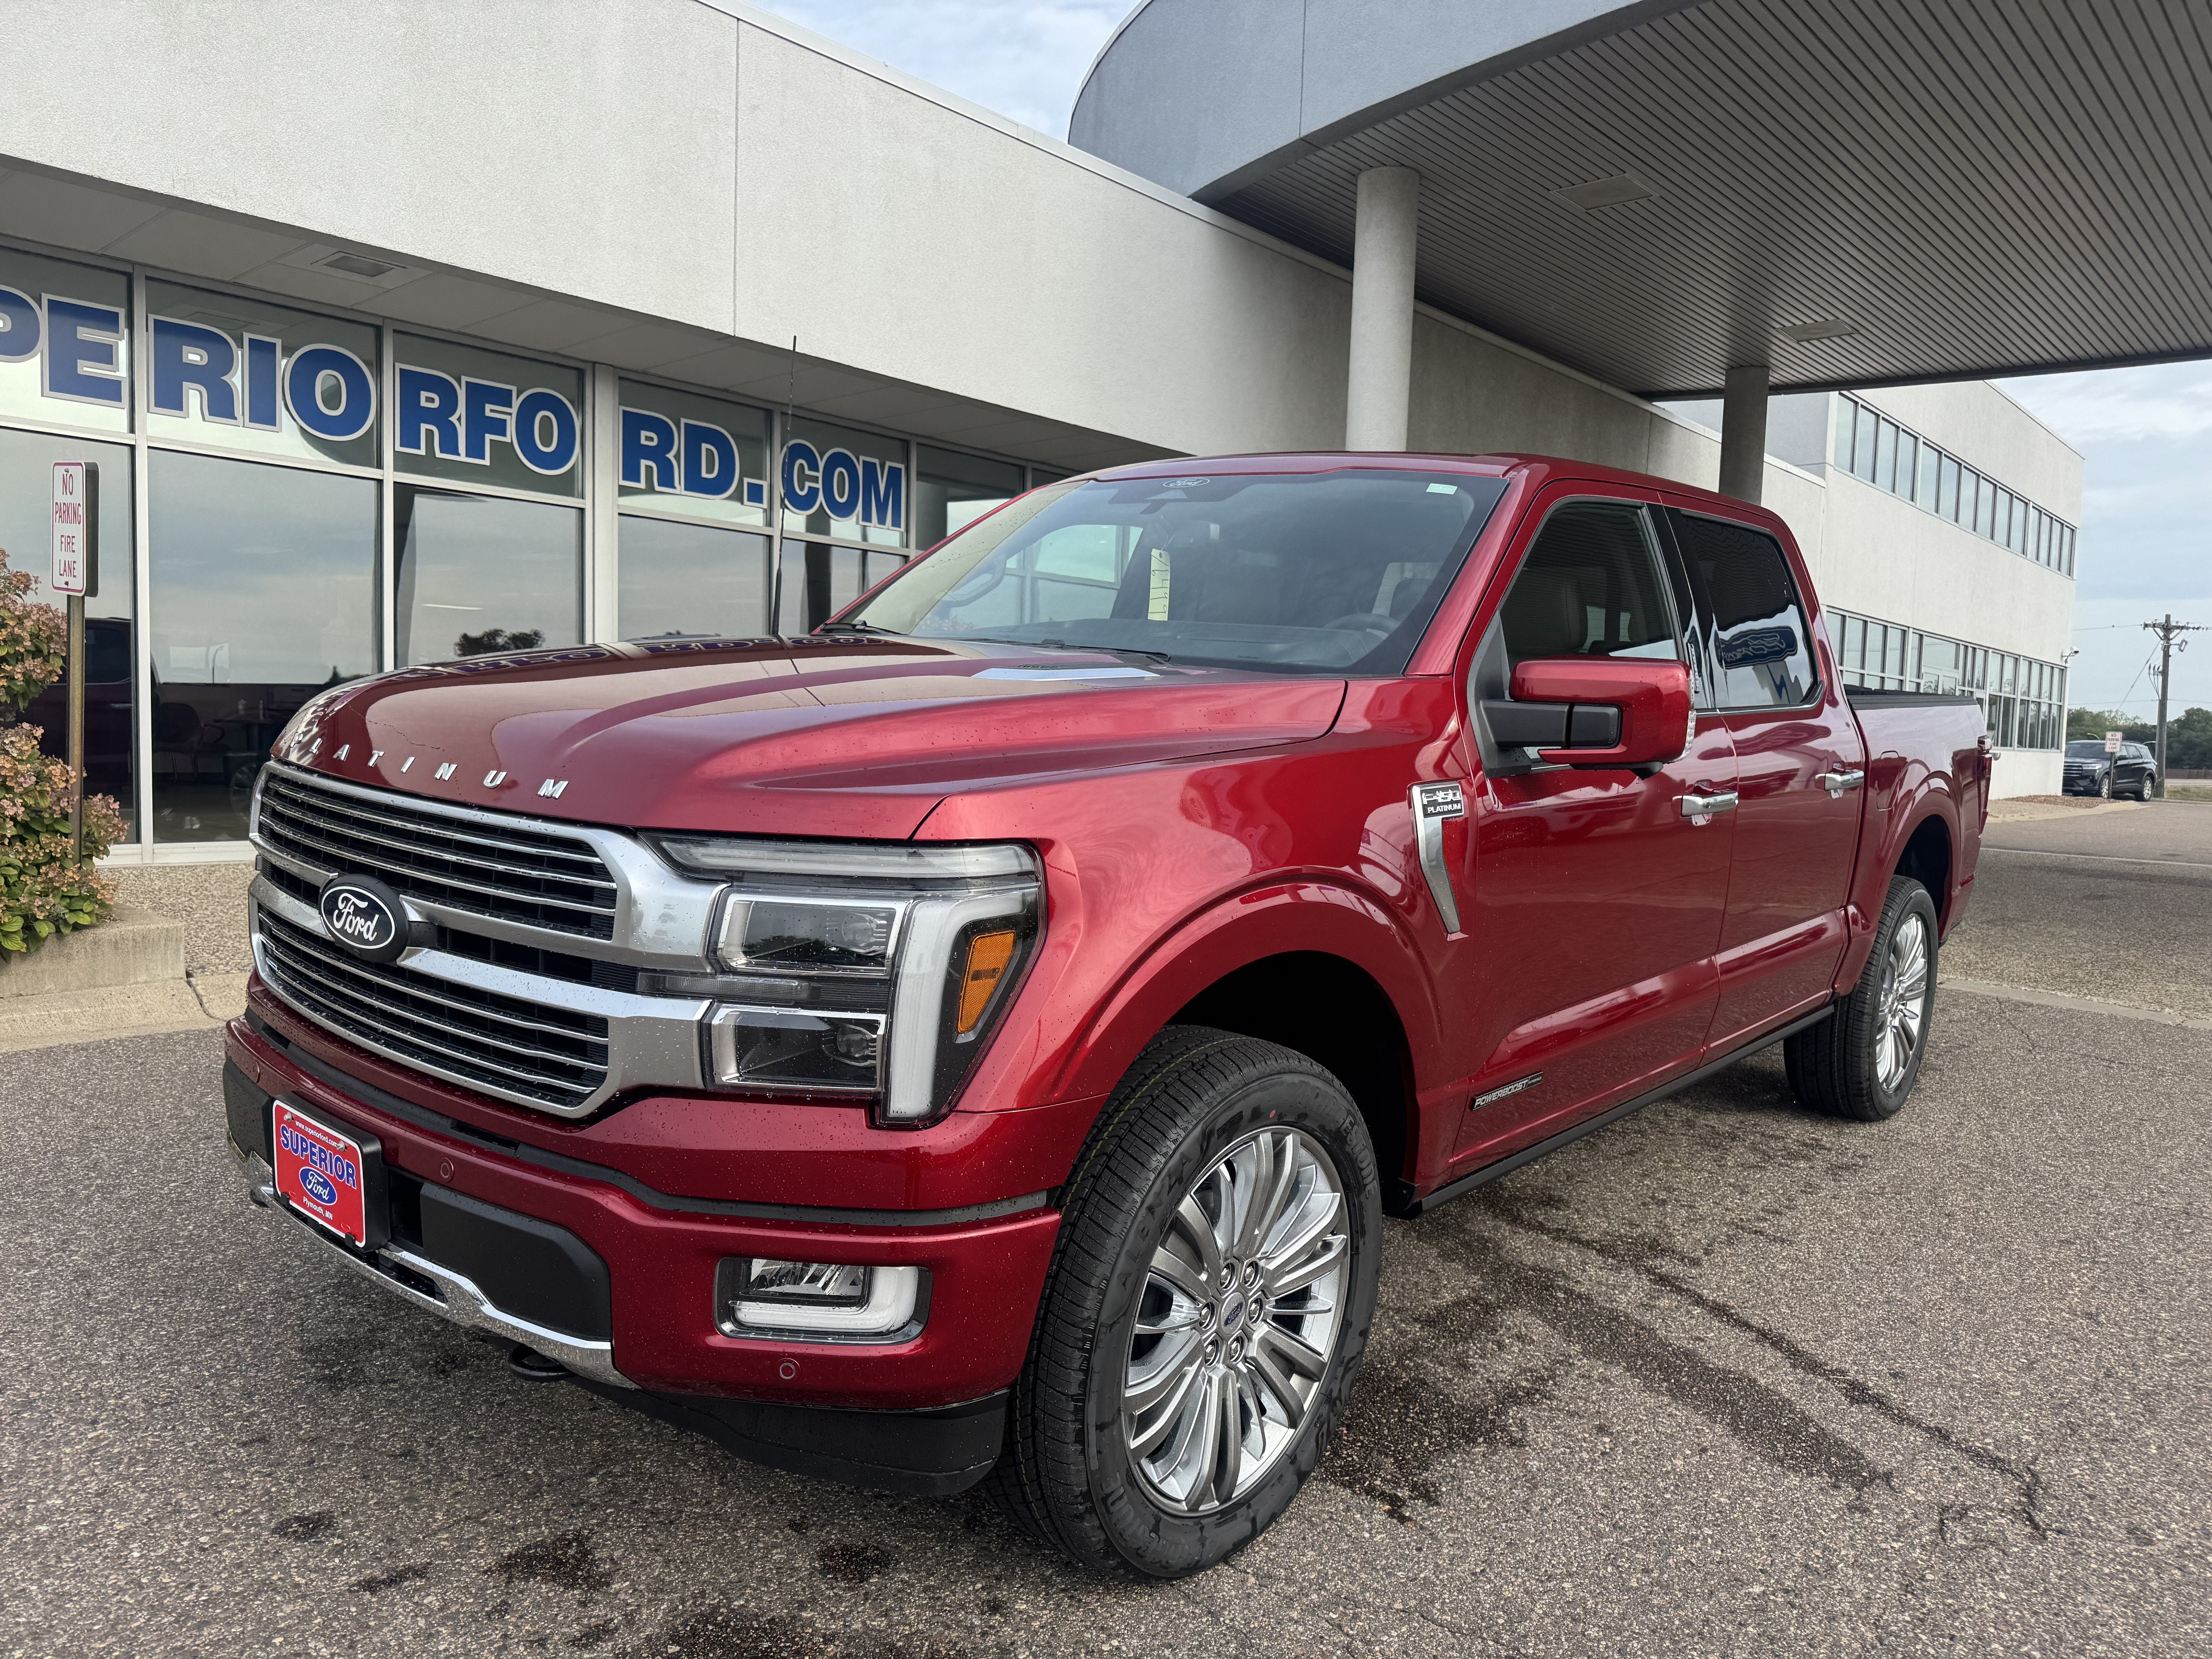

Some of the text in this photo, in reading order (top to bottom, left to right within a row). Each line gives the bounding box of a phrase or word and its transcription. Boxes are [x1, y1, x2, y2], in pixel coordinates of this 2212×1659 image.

[62, 473, 74, 496] NO
[55, 502, 81, 525] PARKING
[60, 535, 75, 553] FIRE
[59, 559, 77, 578] LANE
[290, 733, 568, 799] PLATINUM
[1422, 789, 1461, 804] F-150
[1427, 803, 1461, 814] PLATINUM
[333, 892, 379, 941] Ford
[1474, 1079, 1528, 1108] POWERBOOST
[280, 1124, 357, 1189] SUPERIOR
[306, 1171, 330, 1200] Ford
[303, 1196, 333, 1220] Plymouth, MN
